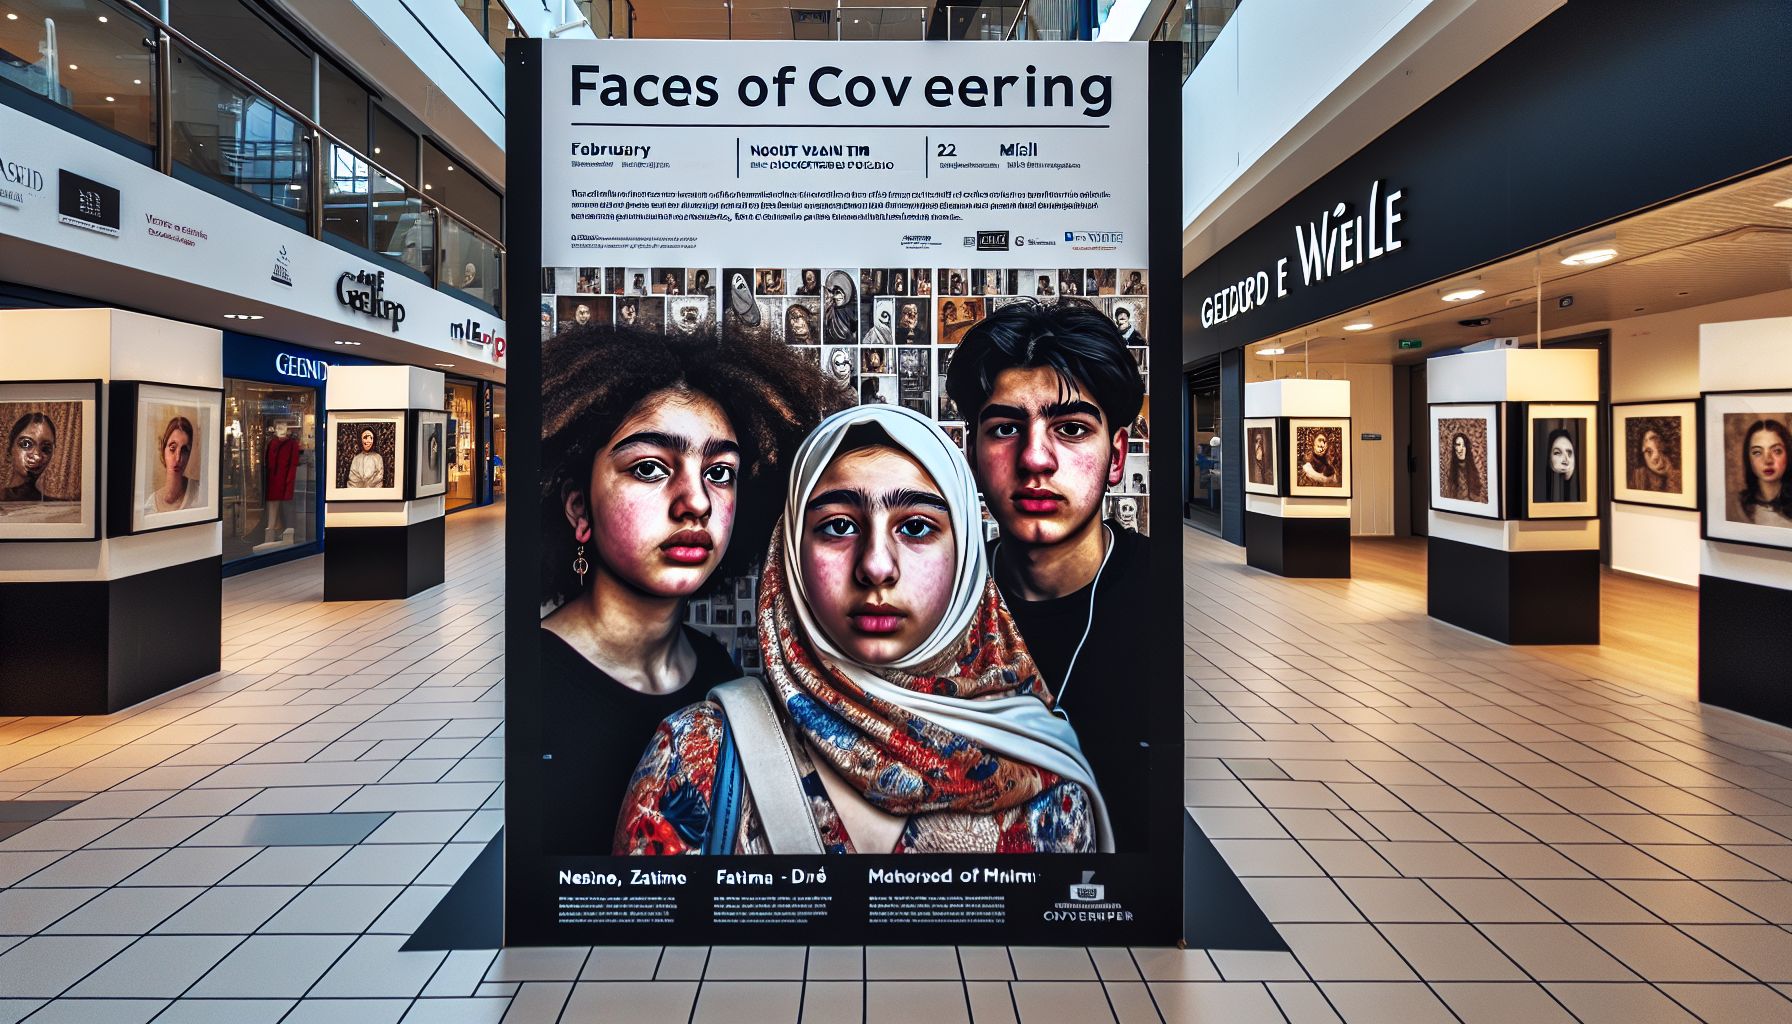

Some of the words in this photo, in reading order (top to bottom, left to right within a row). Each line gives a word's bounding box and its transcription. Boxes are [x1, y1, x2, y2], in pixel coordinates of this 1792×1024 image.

[571, 64, 719, 107] Faces
[737, 65, 797, 107] of
[937, 143, 957, 157] 22
